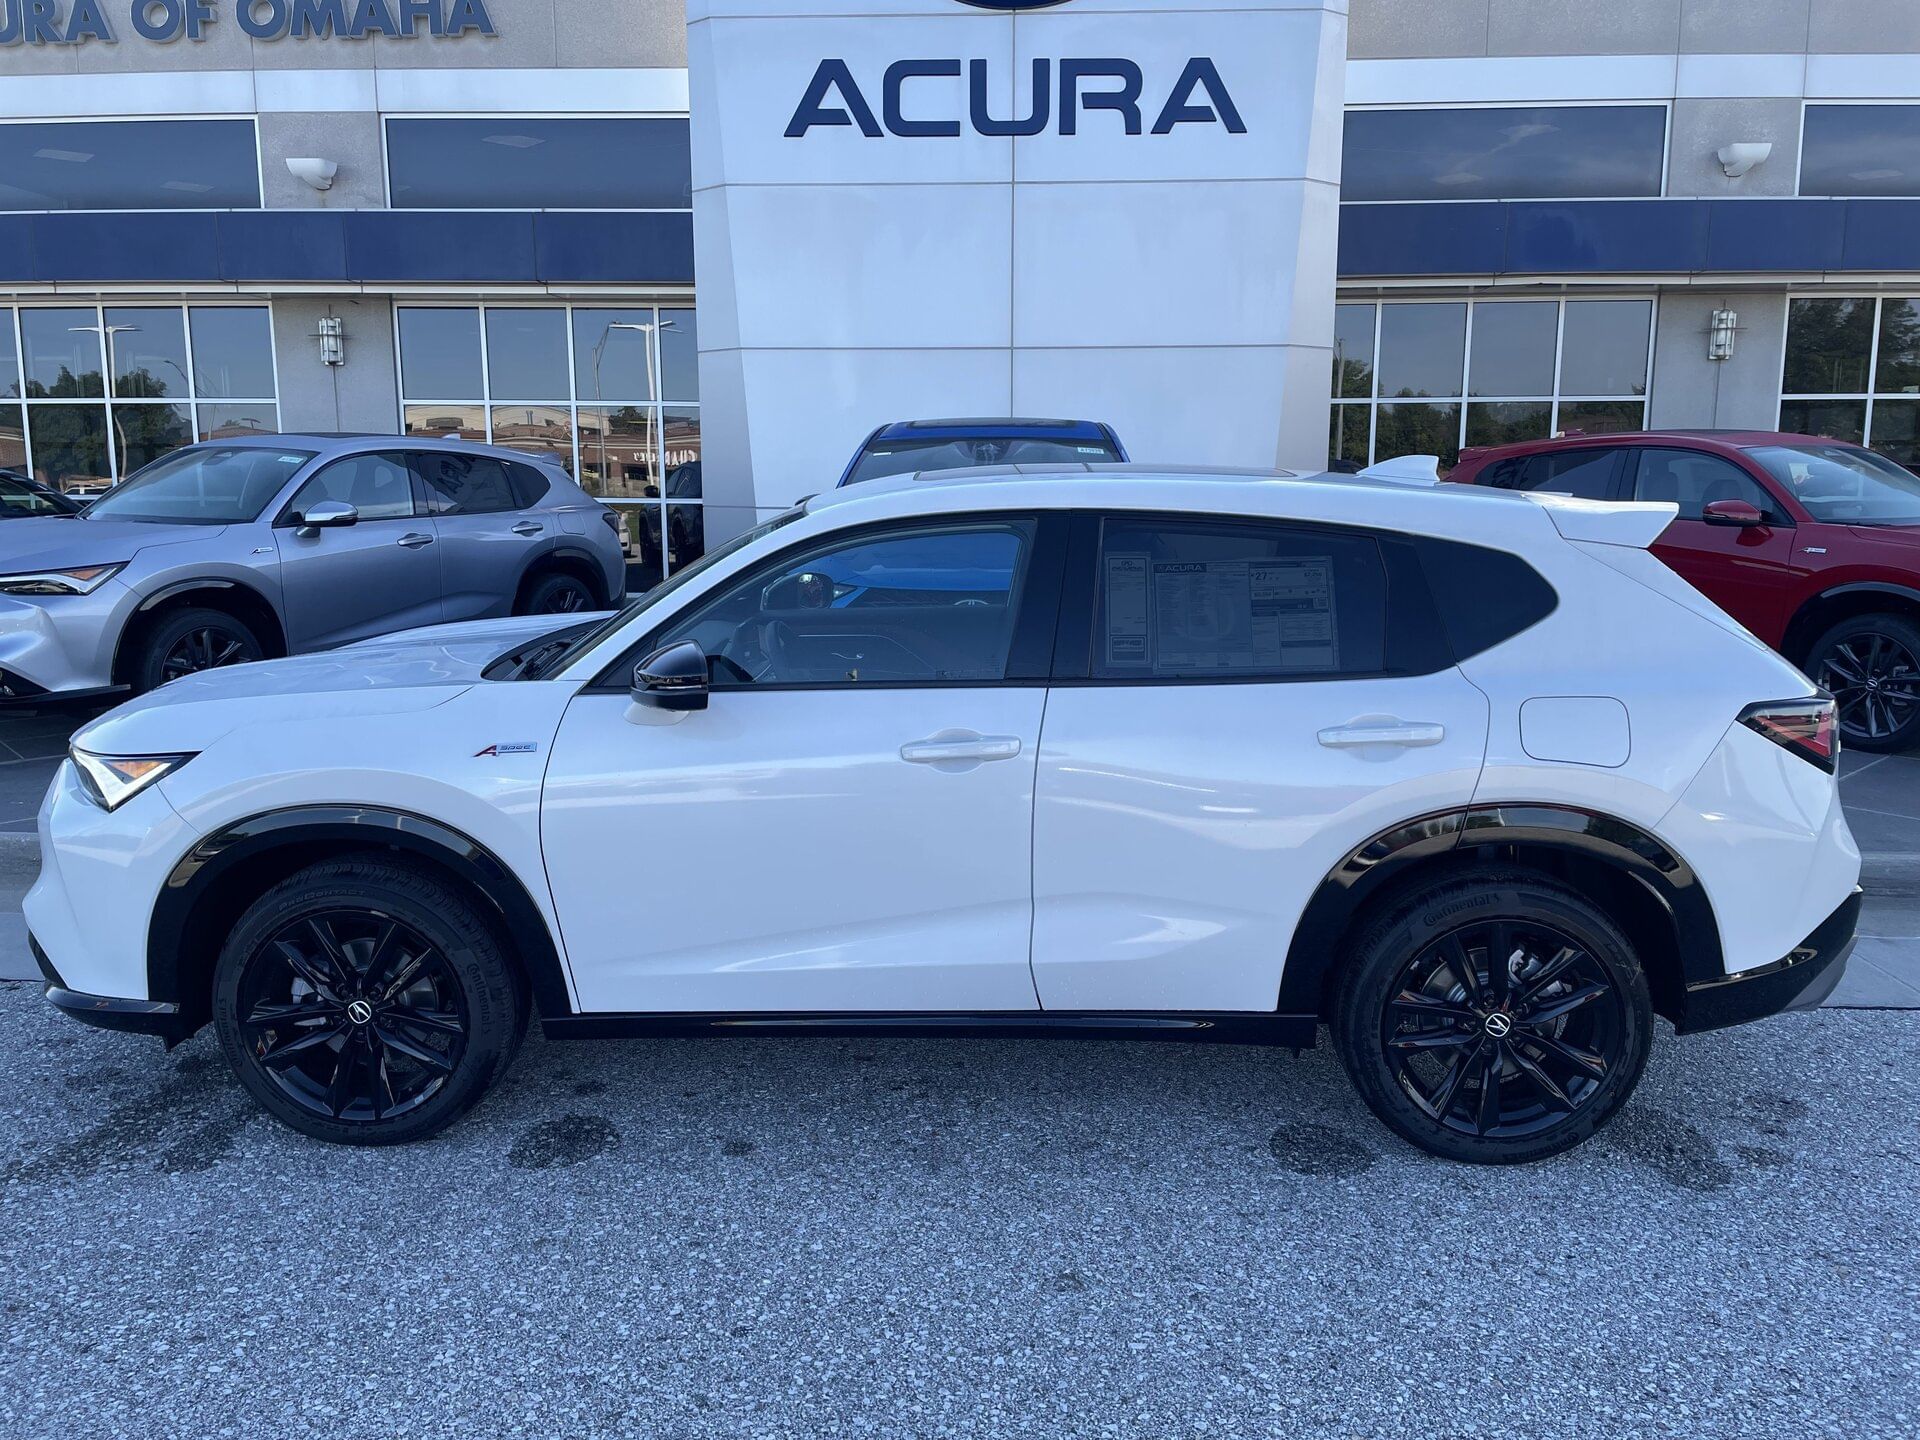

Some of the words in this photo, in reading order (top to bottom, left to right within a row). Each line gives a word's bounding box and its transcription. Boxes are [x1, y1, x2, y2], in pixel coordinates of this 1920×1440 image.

[130, 0, 216, 42] OF
[235, 0, 498, 41] OMAHA
[783, 57, 1247, 137] ACURA
[1165, 564, 1203, 572] ACURA
